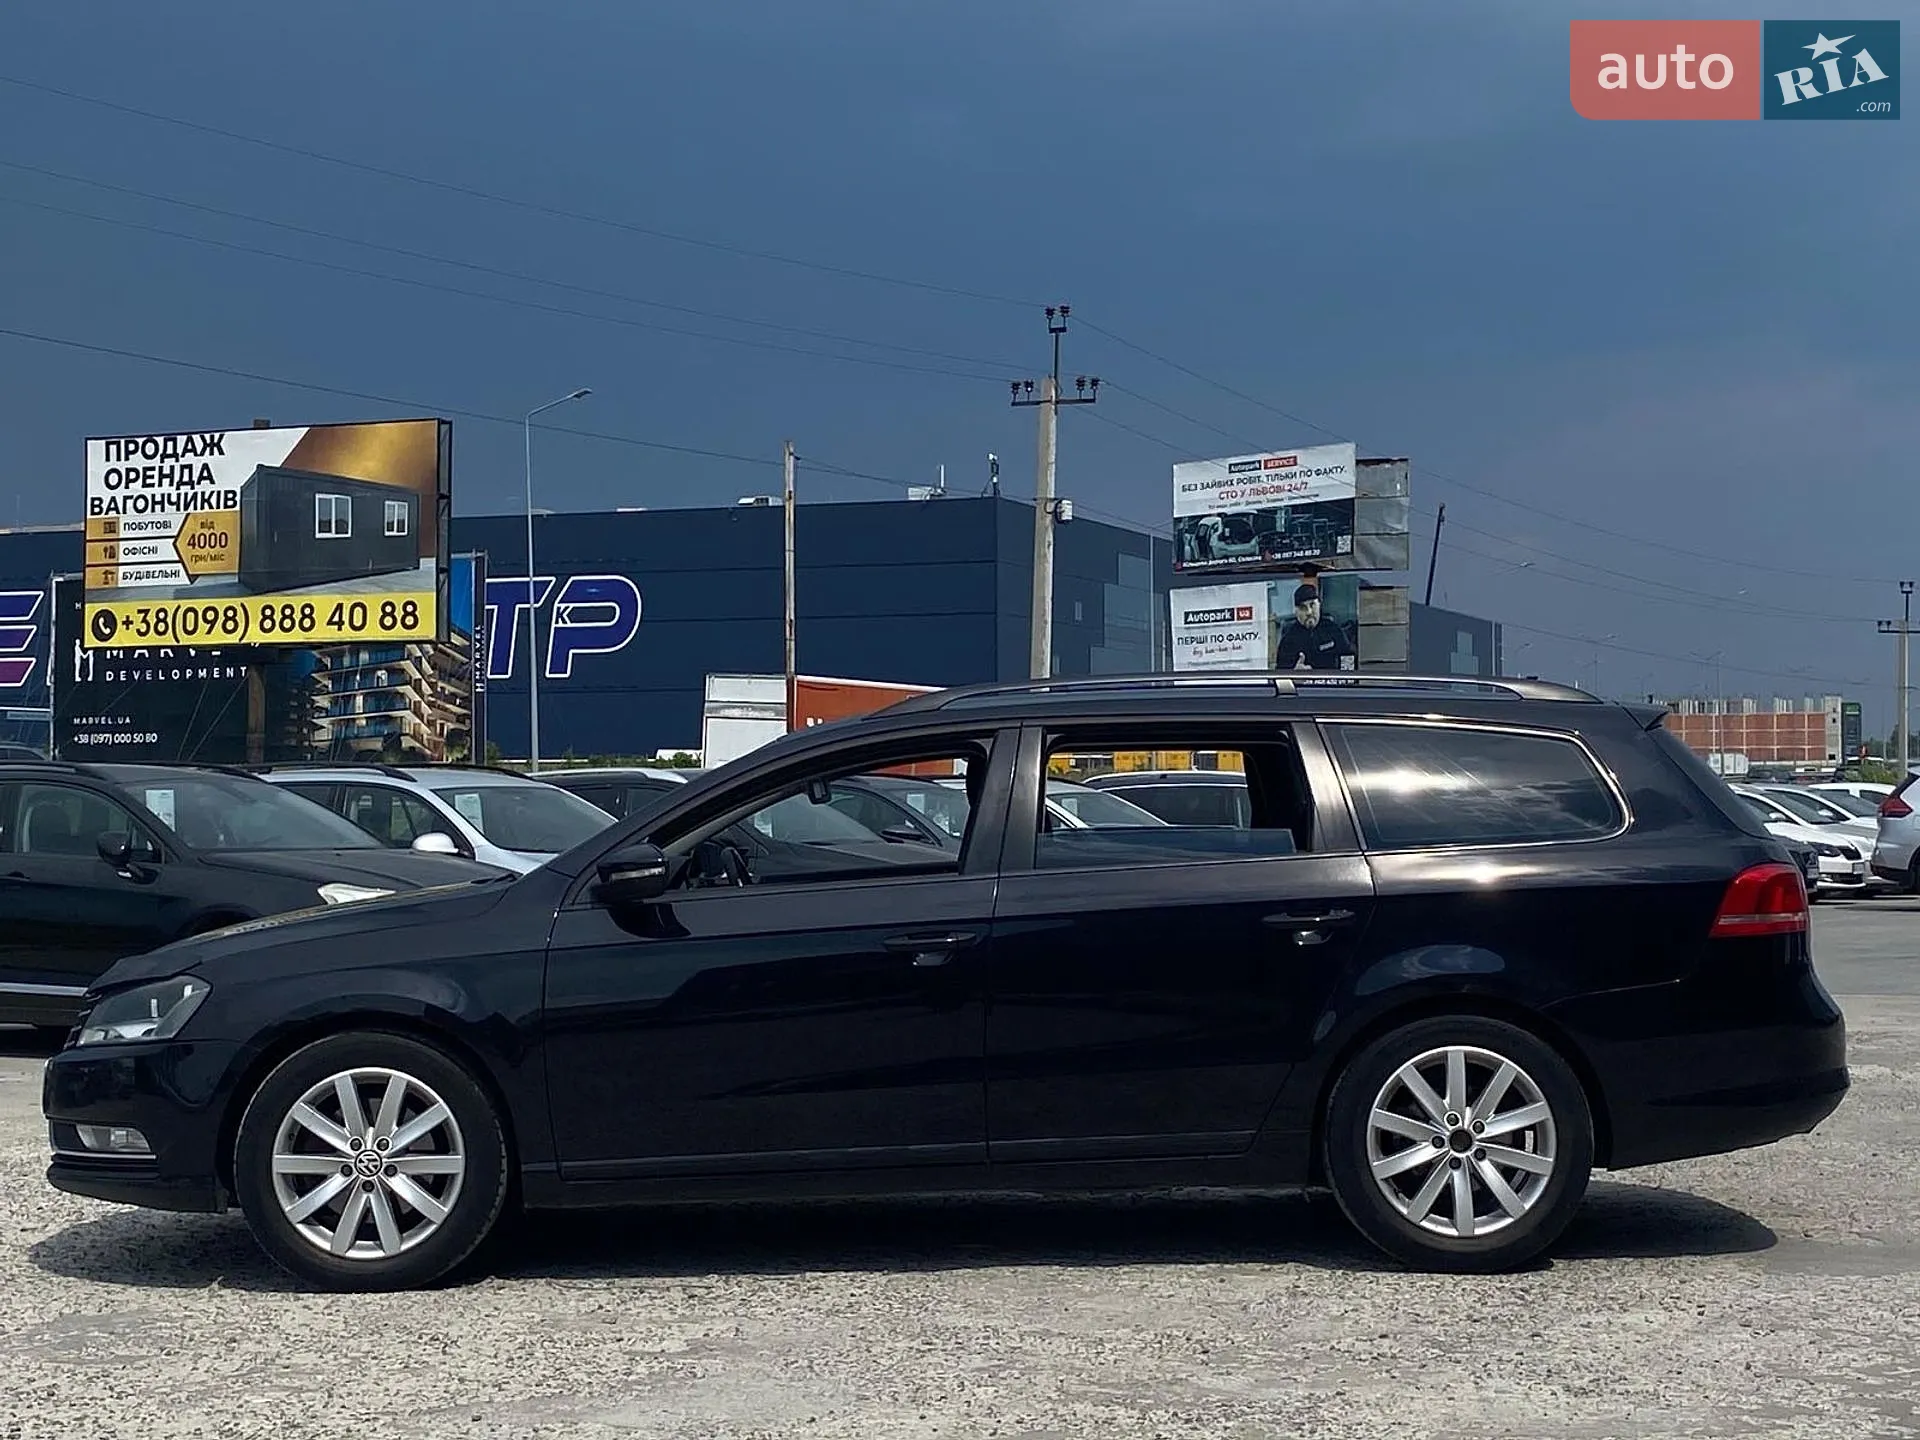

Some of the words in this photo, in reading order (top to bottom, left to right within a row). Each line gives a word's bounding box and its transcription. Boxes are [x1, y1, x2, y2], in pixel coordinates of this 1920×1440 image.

[105, 434, 225, 463] ПРОДАЖ
[104, 463, 216, 490] ОРЕНДА
[1265, 471, 1298, 484] ТІЛЬКИ
[1300, 469, 1313, 479] ПО
[1218, 490, 1239, 501] СТО
[1240, 489, 1248, 499] У
[1286, 482, 1309, 494] 24/7
[90, 490, 238, 516] ВАГОНЧИКІВ
[123, 520, 172, 531] ПОБУТОВІ
[200, 519, 215, 530] від
[187, 532, 228, 550] 4000
[123, 546, 158, 556] ОФІСНІ
[190, 553, 225, 564] грн/міс
[122, 570, 180, 581] БУДІВЕЛЬНІ
[121, 603, 250, 644] +38(098)
[259, 603, 316, 633] 888
[326, 601, 368, 632] 40
[379, 600, 419, 630] 88
[1187, 610, 1232, 623] Autopark
[1177, 634, 1208, 646] ПЕРШІ
[1210, 633, 1225, 644] ПО
[106, 666, 248, 681] DEVELOPMENT
[73, 716, 131, 725] MARVEL.UA
[74, 733, 89, 744] +38
[113, 733, 132, 744] 000
[133, 733, 144, 743] 50
